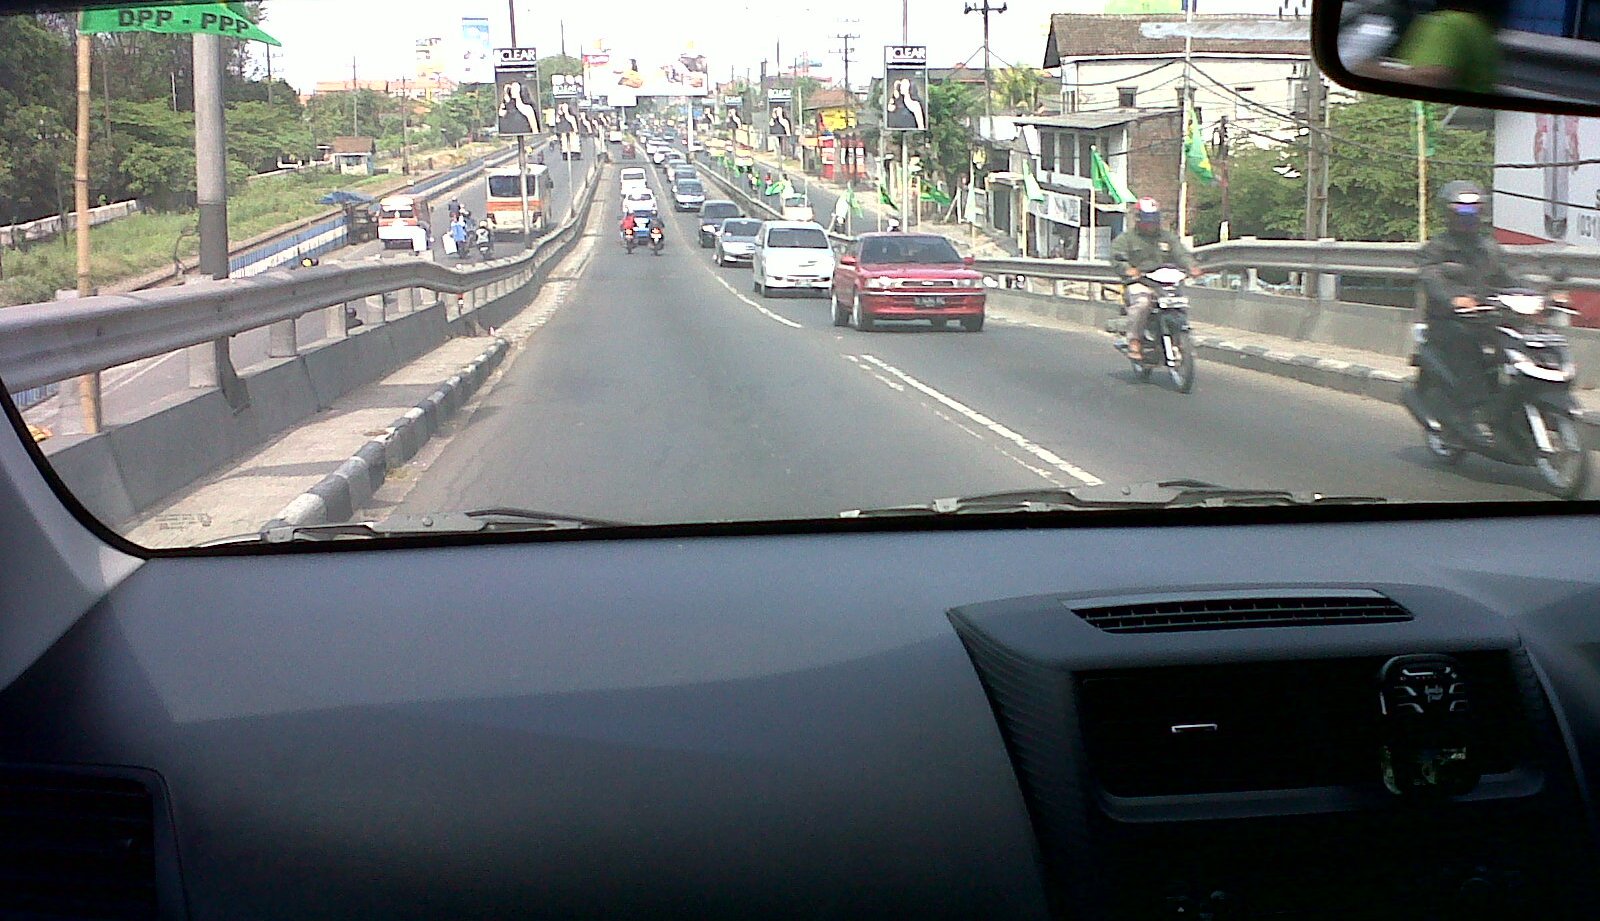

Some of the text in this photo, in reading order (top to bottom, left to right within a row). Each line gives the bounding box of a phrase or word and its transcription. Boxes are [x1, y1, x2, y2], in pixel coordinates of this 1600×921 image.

[119, 10, 172, 26] DPP
[202, 12, 249, 33] PPP
[500, 49, 536, 61] CLEAR
[892, 47, 926, 59] CLEAR
